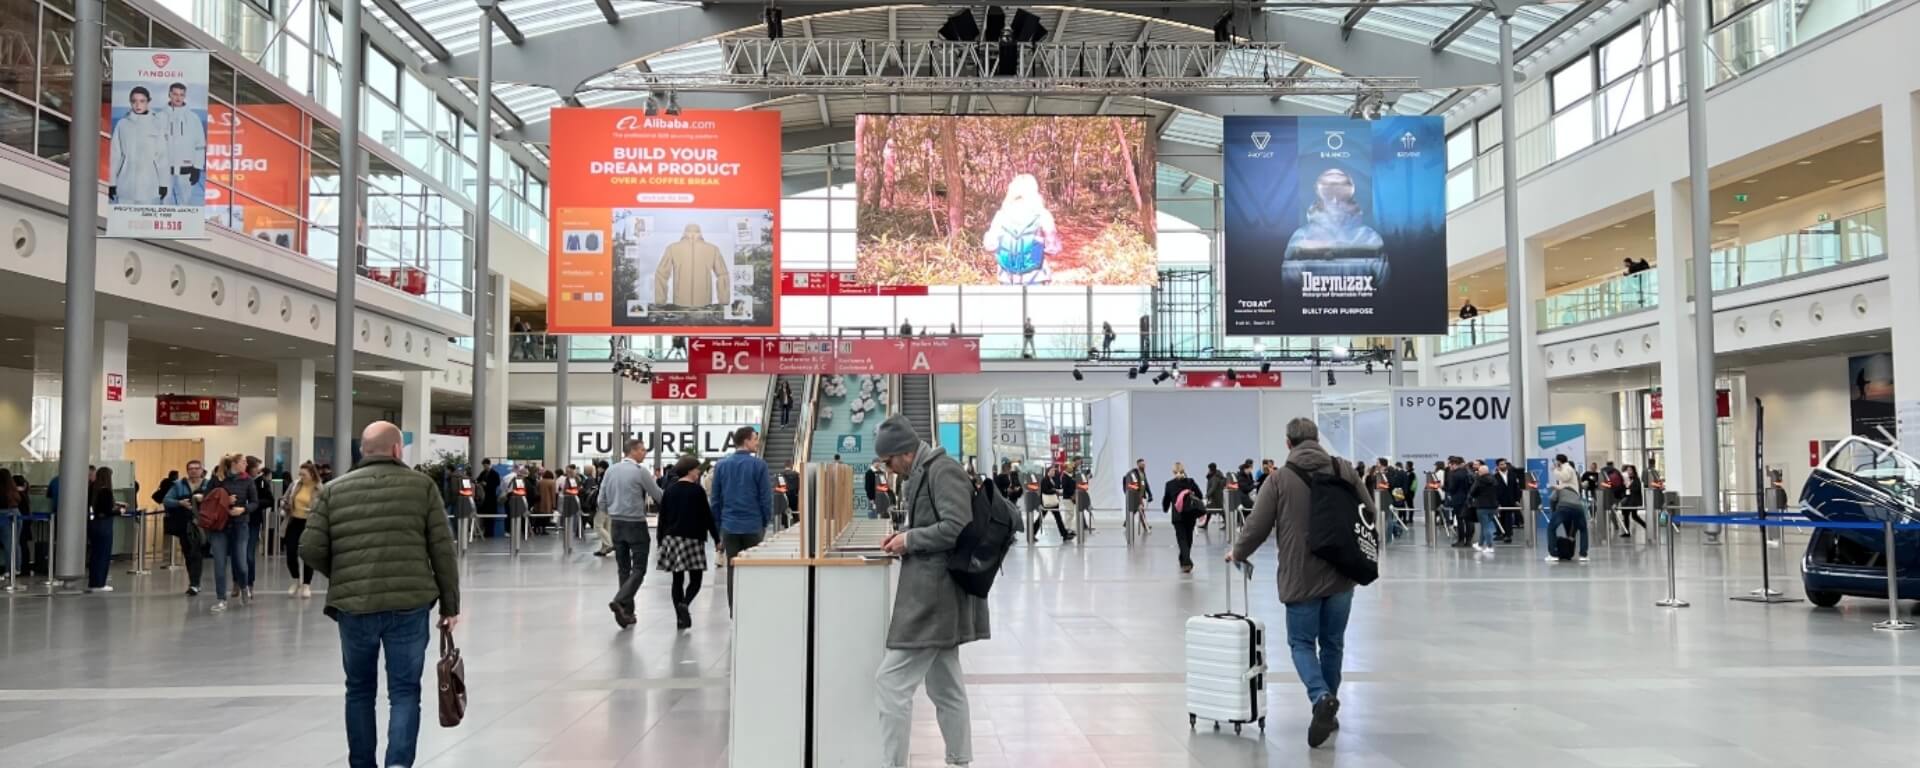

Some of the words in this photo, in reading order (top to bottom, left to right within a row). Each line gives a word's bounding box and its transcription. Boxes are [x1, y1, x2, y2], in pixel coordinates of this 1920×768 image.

[644, 118, 716, 129] Alibaba.com
[614, 148, 666, 160] BUILD
[670, 148, 718, 161] YOUR
[591, 162, 653, 174] DREAM
[658, 163, 741, 176] PRODUCT
[611, 176, 637, 184] OVER
[649, 177, 686, 185] COFFEE
[688, 177, 720, 186] BREAK
[1302, 272, 1374, 291] Dermizax
[711, 351, 750, 373] B,C
[912, 351, 931, 370] A
[668, 383, 698, 399] B,C
[1400, 396, 1436, 407] ISPO
